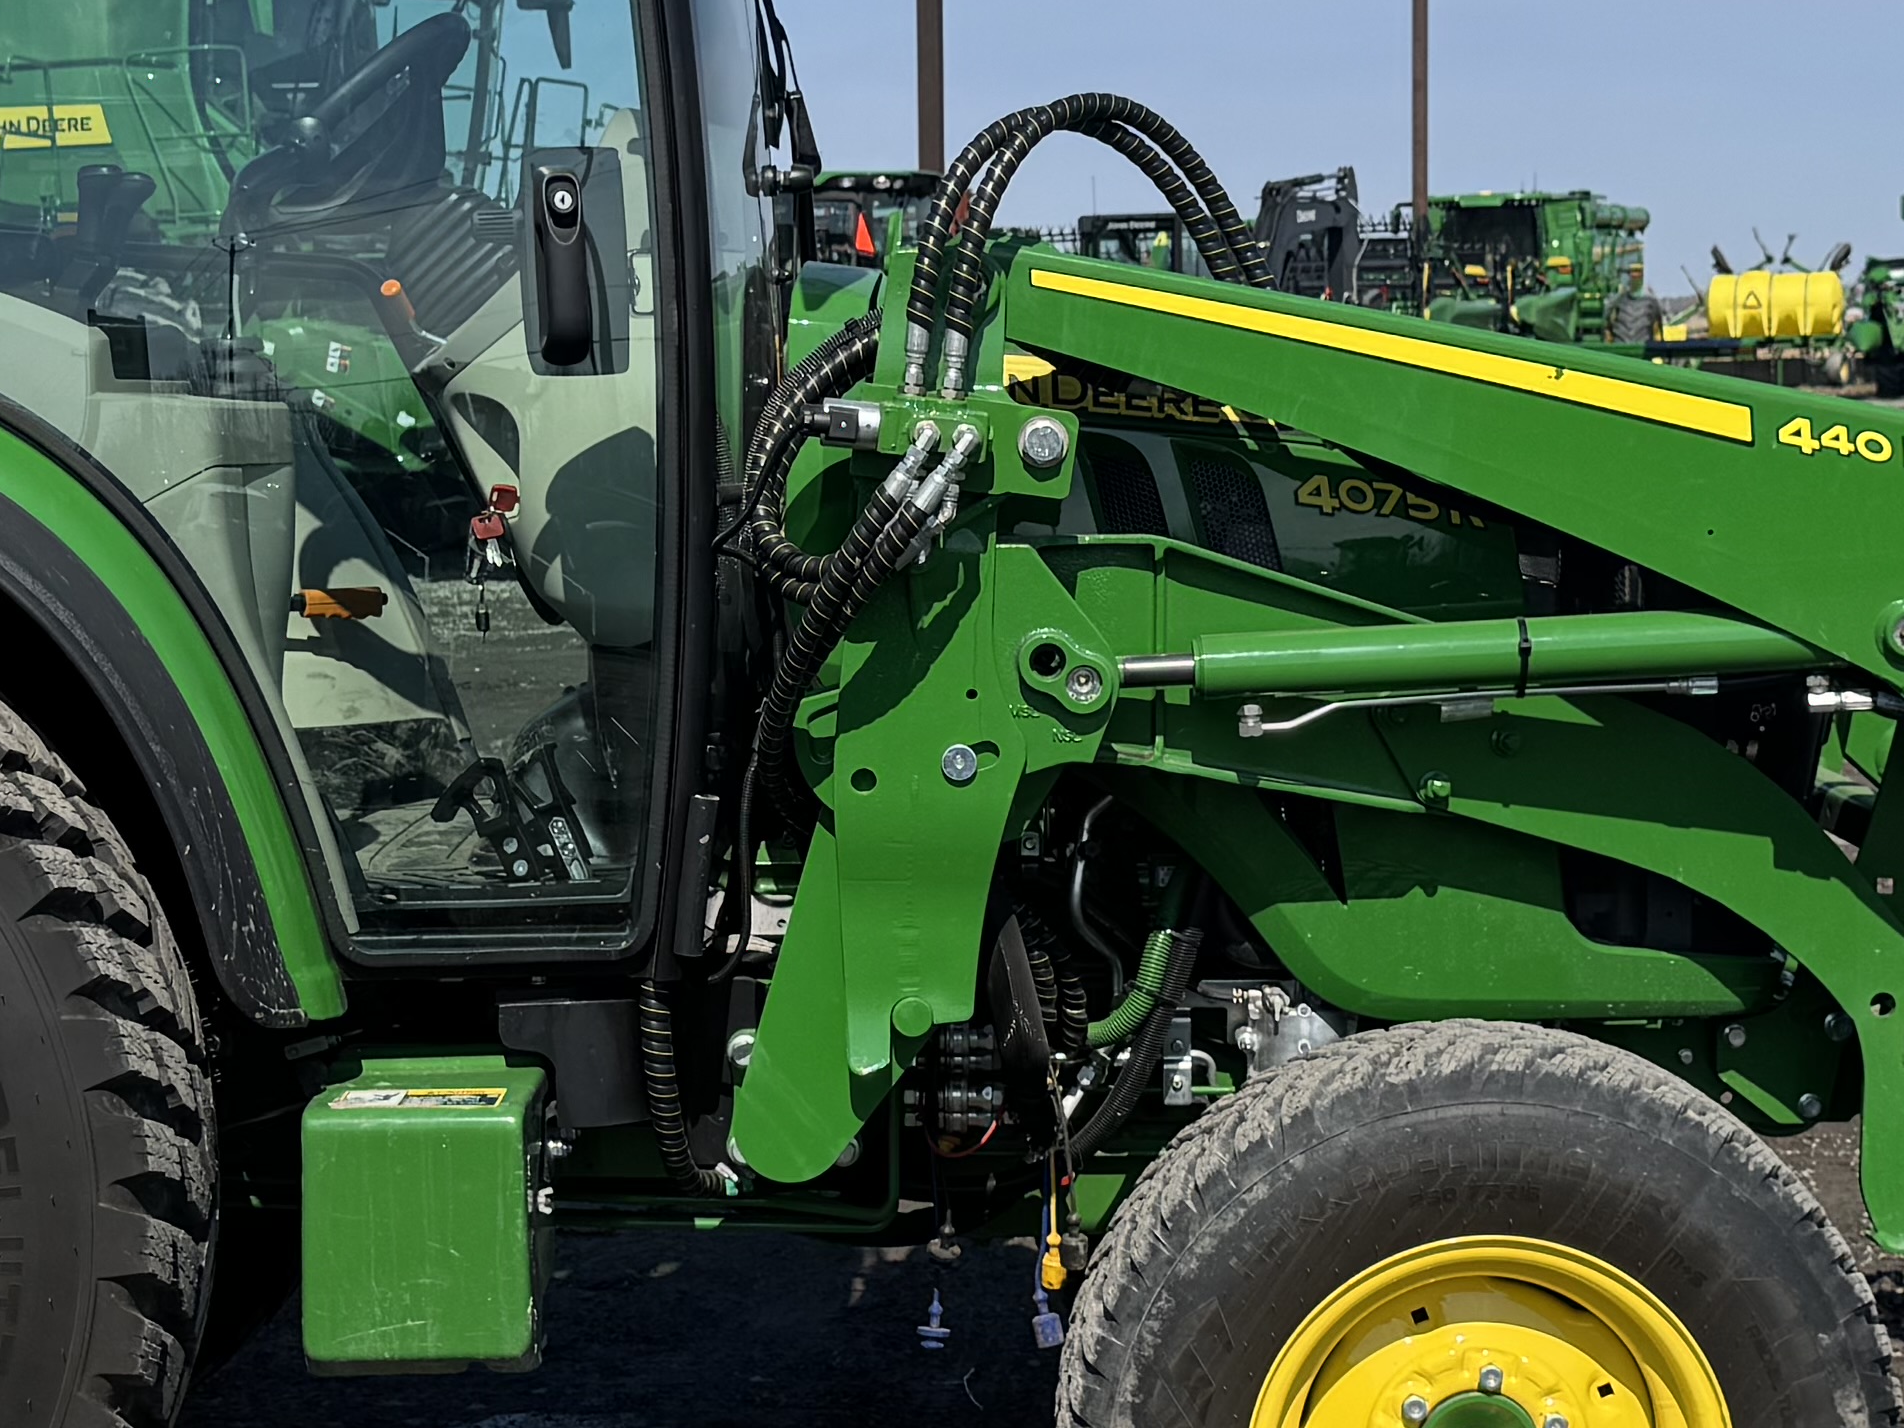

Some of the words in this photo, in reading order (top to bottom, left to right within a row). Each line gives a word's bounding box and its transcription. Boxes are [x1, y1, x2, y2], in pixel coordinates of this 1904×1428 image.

[26, 116, 92, 136] DEERE
[1777, 416, 1893, 463] 440
[1296, 474, 1440, 521] 4075
